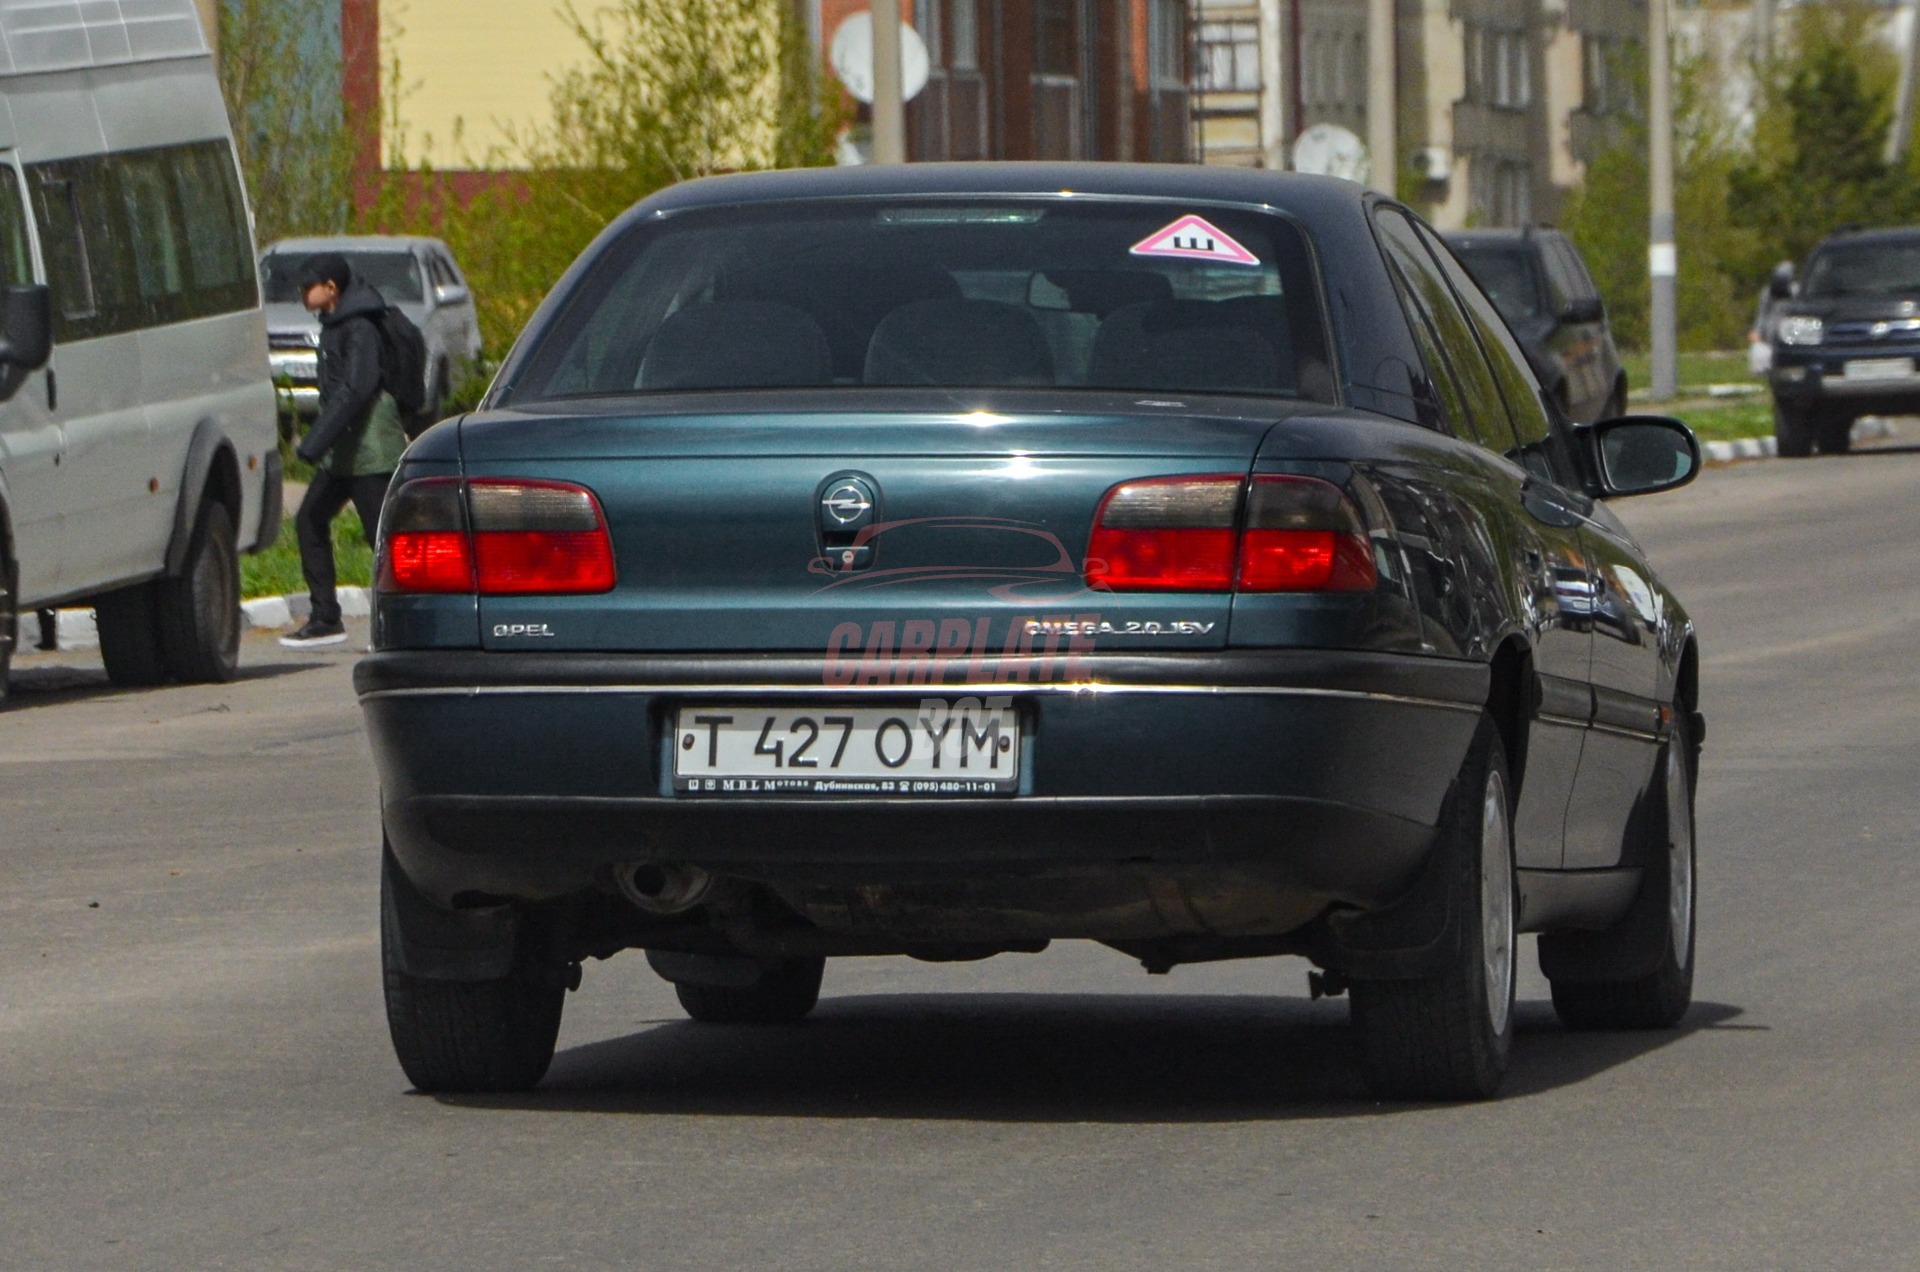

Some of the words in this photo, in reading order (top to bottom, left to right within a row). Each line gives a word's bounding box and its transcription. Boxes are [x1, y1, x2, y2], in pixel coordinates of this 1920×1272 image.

[1174, 236, 1214, 251] Ш
[493, 623, 555, 637] OPEL
[1024, 620, 1114, 635] OMEGA
[1125, 621, 1162, 636] 2.0
[1171, 621, 1215, 635] 16V
[694, 716, 734, 767] T
[754, 716, 854, 768] 427
[874, 717, 1000, 769] OYM
